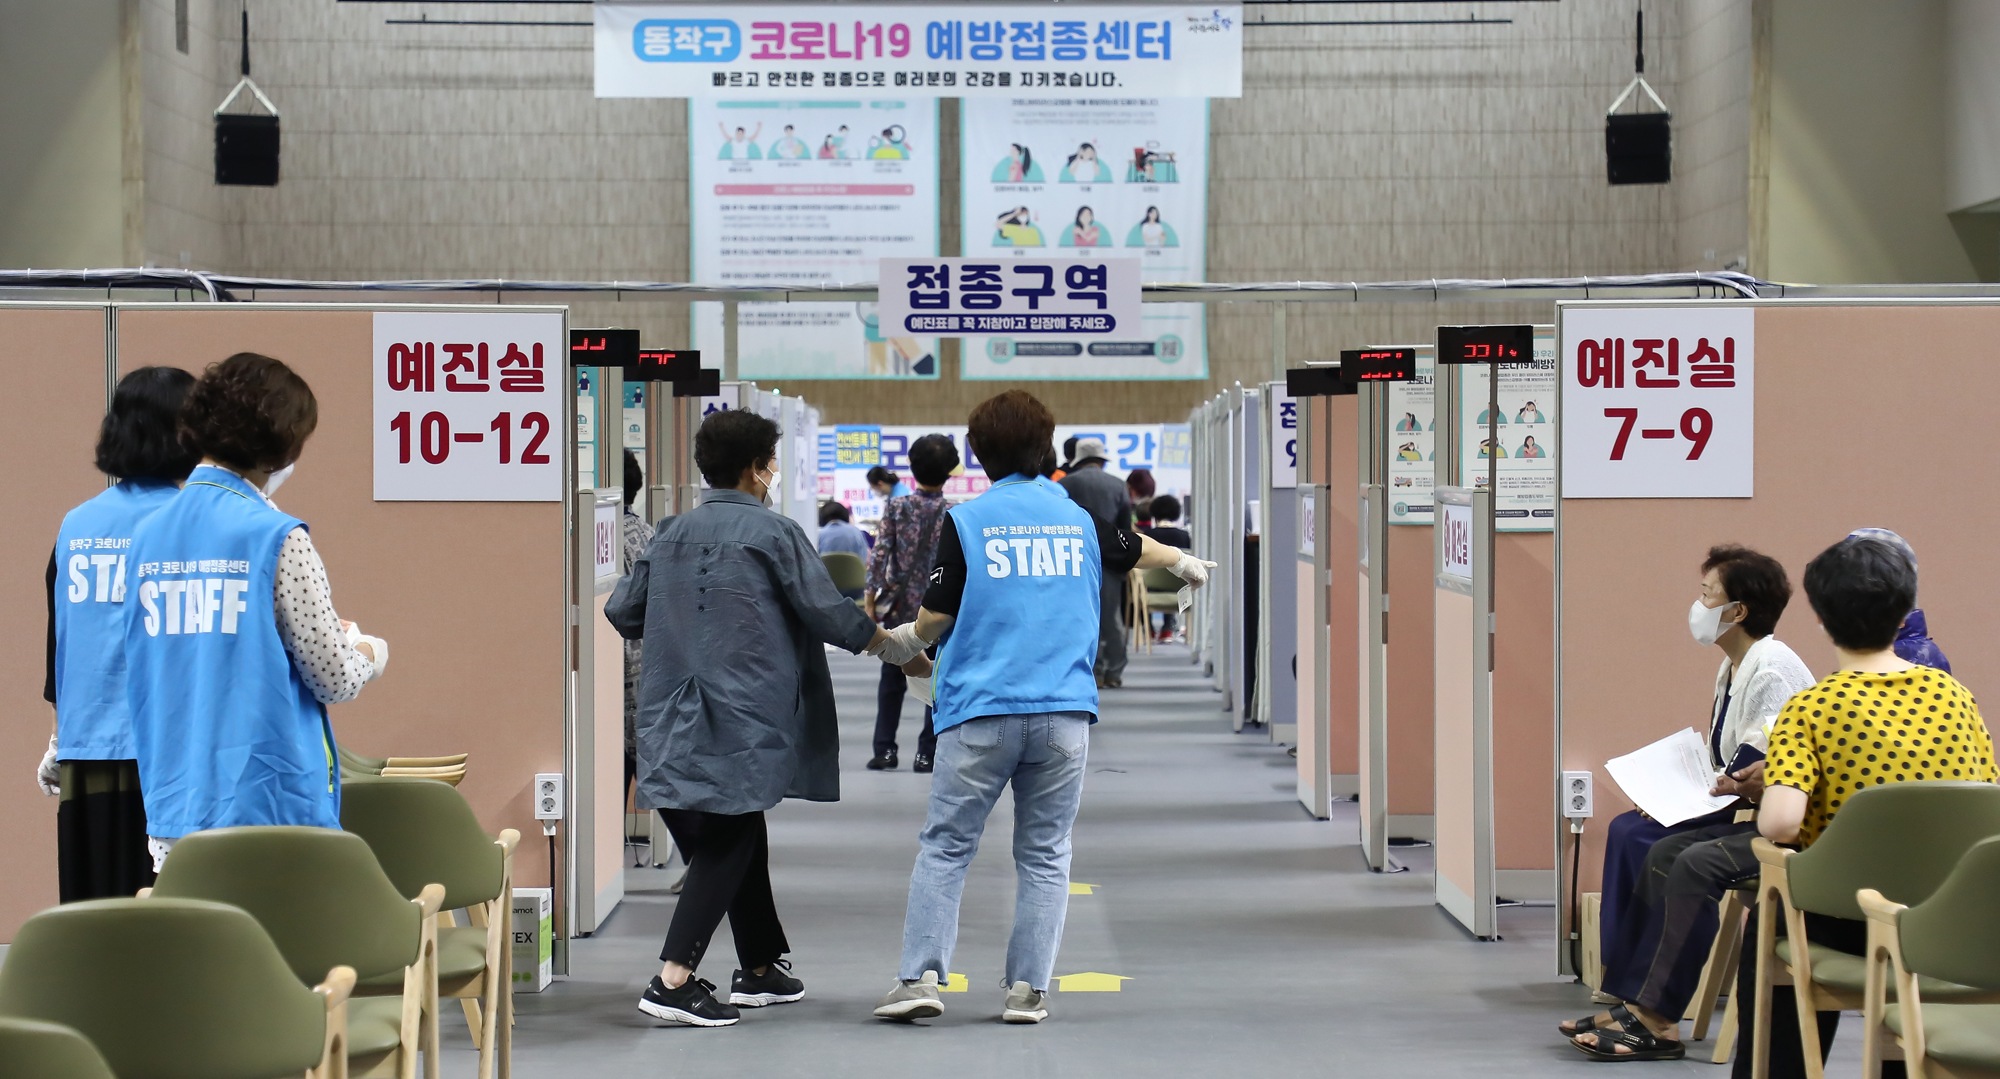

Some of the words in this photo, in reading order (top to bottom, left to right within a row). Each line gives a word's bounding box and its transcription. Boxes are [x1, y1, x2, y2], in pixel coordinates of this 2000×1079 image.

[643, 26, 733, 56] 동작구
[750, 21, 910, 60] 코로나19
[926, 20, 1172, 61] 예방접종센터
[712, 72, 760, 87] 빠르고
[767, 71, 815, 87] 안전한
[823, 72, 886, 87] 접종으로
[894, 72, 957, 87] 여러분의
[965, 71, 1011, 87] 건강을
[1020, 71, 1123, 87] 지키겠습니다.
[907, 263, 1108, 310] 접종구역
[911, 317, 960, 330] 예진표를
[962, 317, 976, 330] 꼭
[978, 317, 1027, 330] 지참하고
[1030, 317, 1066, 330] 입장해
[1069, 317, 1110, 330] 주세요.
[387, 341, 546, 393] 예진실
[1577, 336, 1736, 389] 예진실
[390, 410, 550, 465] 10-12
[1604, 406, 1714, 461] 7-9
[69, 539, 92, 550] 동작구
[95, 538, 131, 550] 코로나19
[983, 526, 1008, 538] 동작구
[1009, 525, 1040, 535] 코로나19
[1042, 525, 1084, 536] 예방접종센터
[68, 554, 127, 604] STA
[138, 561, 160, 578] 동작구
[162, 561, 197, 575] 코로나19
[199, 560, 250, 575] 예방접종센터
[985, 538, 1084, 579] STAFF
[139, 579, 249, 638] STAFF
[511, 932, 533, 943] EX
